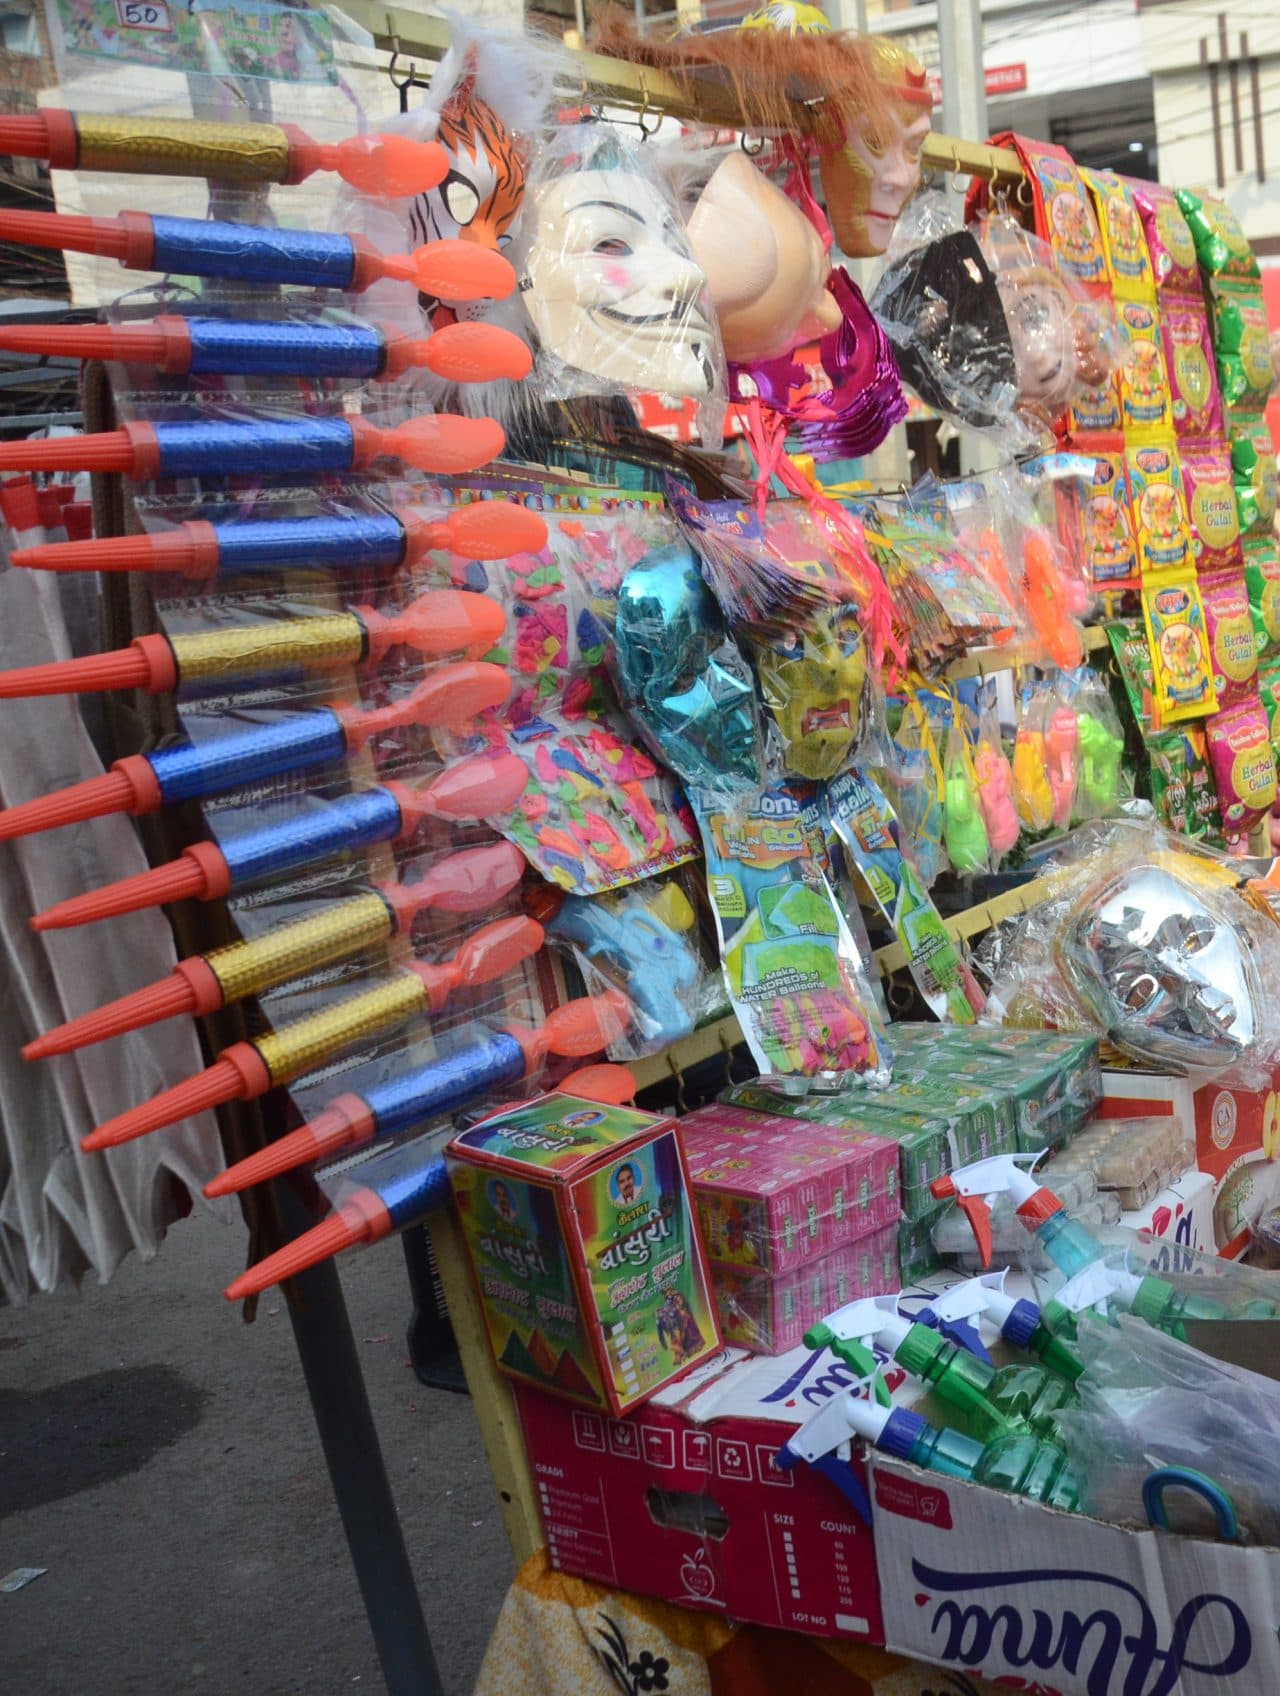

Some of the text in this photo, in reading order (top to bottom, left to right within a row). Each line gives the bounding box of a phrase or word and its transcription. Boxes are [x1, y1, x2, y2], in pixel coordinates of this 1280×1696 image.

[126, 4, 158, 23] 50
[1201, 499, 1233, 513] Herbal
[1206, 513, 1233, 527] Gulal
[1224, 632, 1252, 648] Herbal
[1242, 756, 1273, 780] Herbal
[1248, 772, 1274, 792] Gulal
[714, 879, 735, 896] 3
[741, 973, 808, 995] HUNDREDS
[737, 990, 778, 1004] WATER
[600, 1208, 671, 1272] बांसुरी
[774, 1513, 857, 1535] SIZE COUNT
[792, 1612, 827, 1626] LOT NO
[912, 1557, 1252, 1696] Alma
